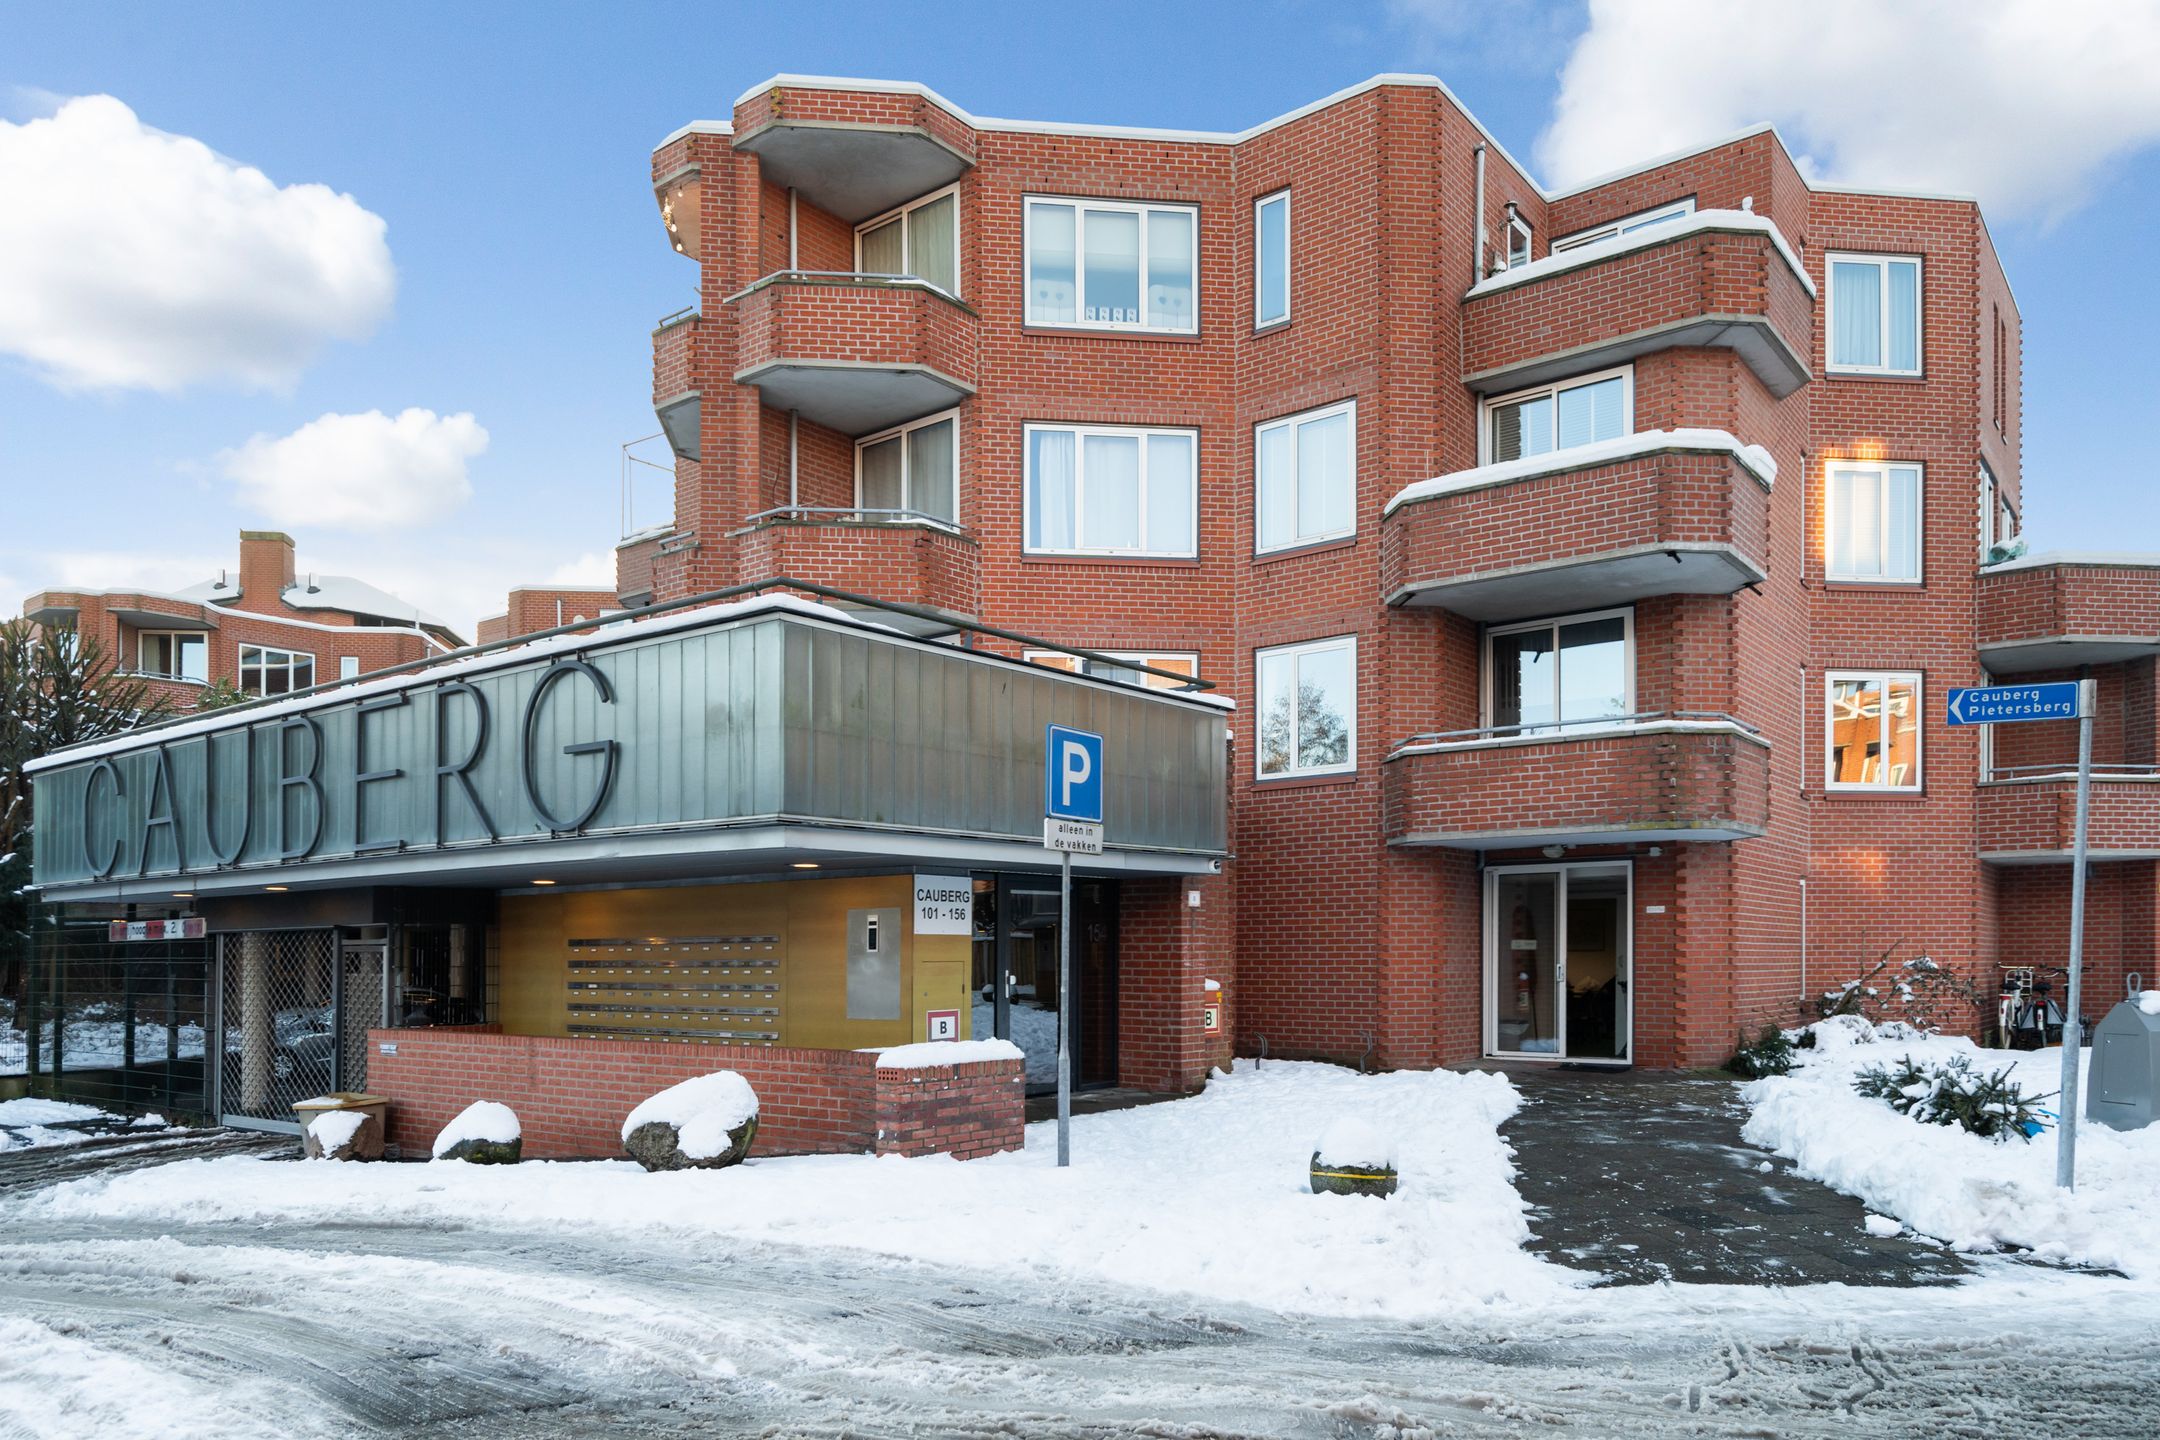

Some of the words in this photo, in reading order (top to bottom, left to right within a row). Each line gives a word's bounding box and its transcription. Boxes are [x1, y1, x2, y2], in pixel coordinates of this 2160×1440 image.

[1969, 690, 2040, 702] Cauberg
[1969, 702, 2071, 716] Pietersberg
[83, 659, 615, 877] CAUBERG
[1062, 740, 1091, 807] P
[1058, 823, 1084, 836] alleen
[1085, 825, 1093, 837] in
[1054, 838, 1064, 849] de
[1067, 839, 1097, 852] vakken
[916, 888, 970, 903] CAUBERG
[921, 906, 938, 920] 101
[949, 908, 966, 920] 156
[1205, 1010, 1212, 1026] B
[940, 1020, 948, 1035] B
